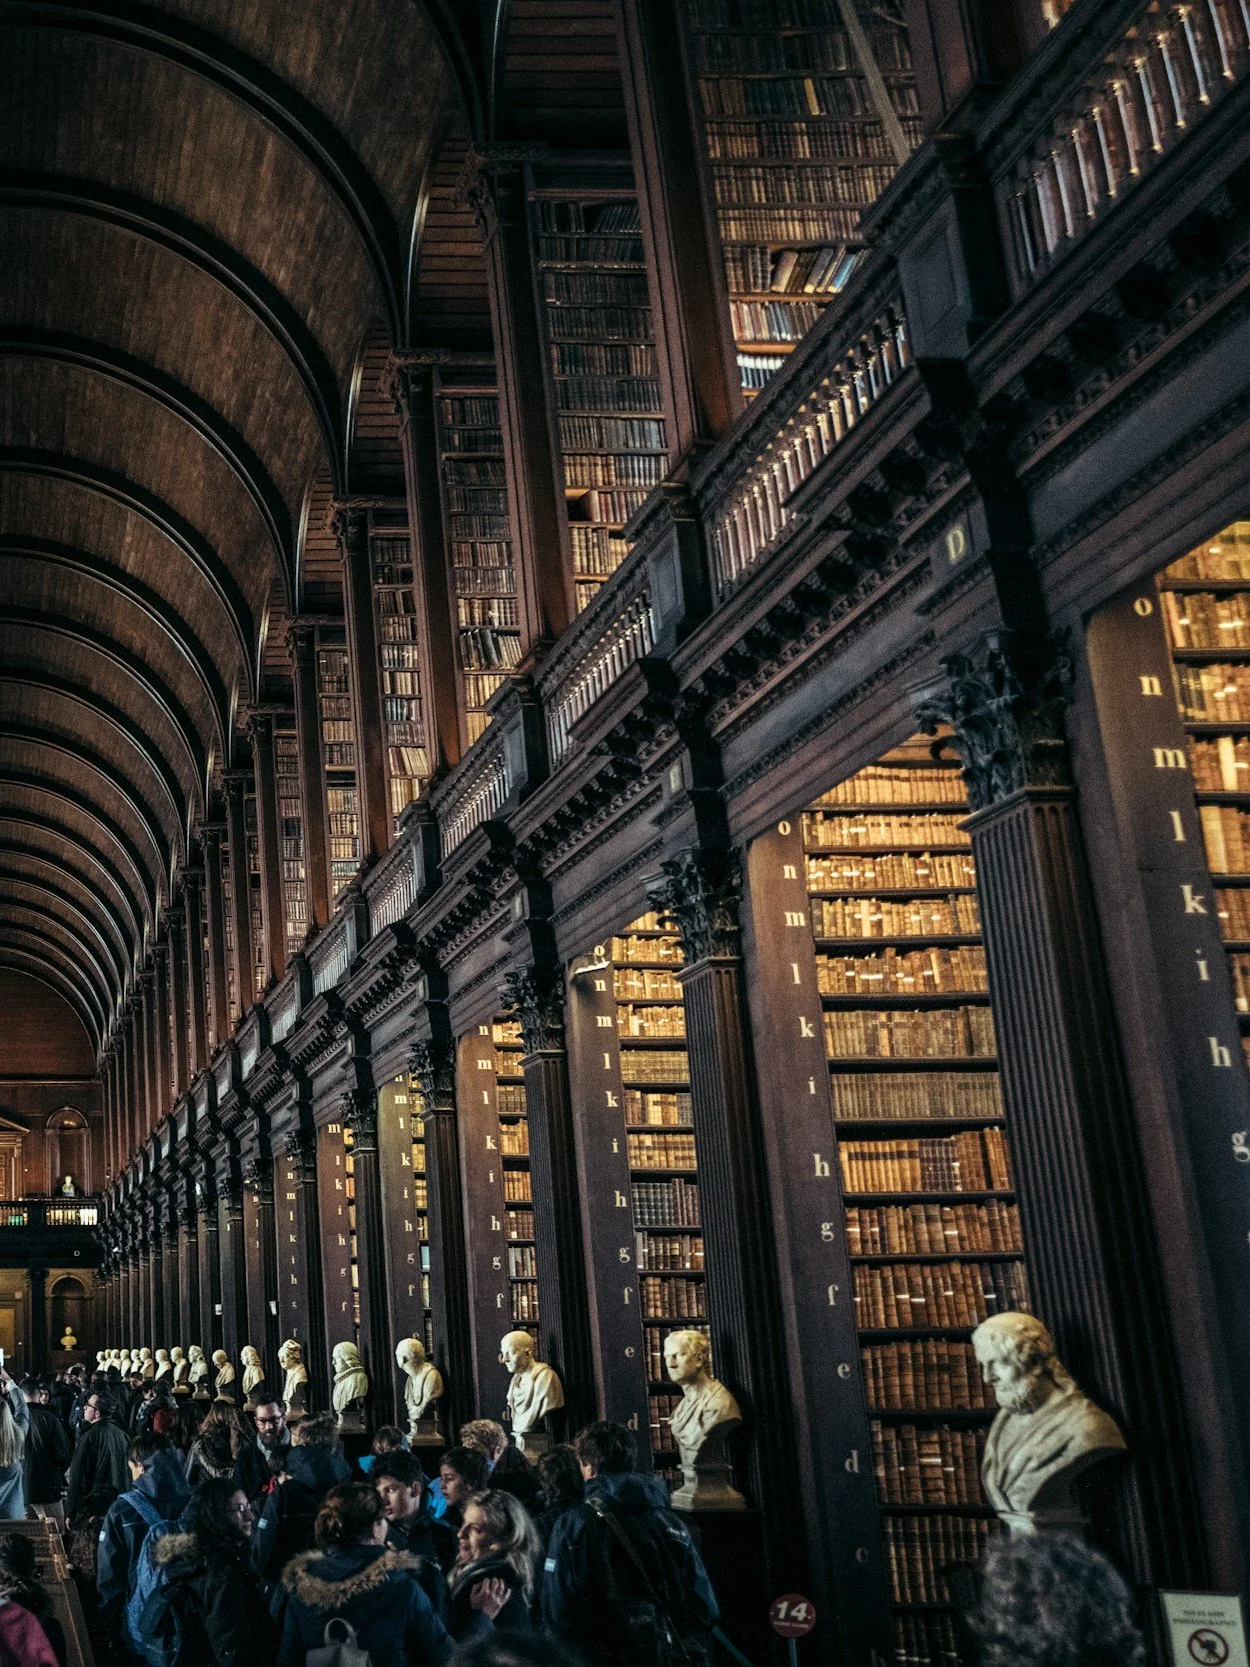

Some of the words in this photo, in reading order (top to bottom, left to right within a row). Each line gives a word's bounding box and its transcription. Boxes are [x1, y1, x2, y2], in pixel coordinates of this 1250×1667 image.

[1134, 599, 1152, 616] o
[1140, 676, 1162, 695] n
[1154, 748, 1186, 768] m
[778, 821, 791, 835] o
[1170, 811, 1185, 841] l
[784, 865, 797, 879] n
[1181, 885, 1207, 913] k
[785, 912, 805, 926] m
[594, 946, 605, 956] o
[791, 963, 800, 984] l
[1196, 950, 1209, 981] i
[595, 980, 606, 991] n
[597, 1016, 612, 1027] m
[799, 1017, 814, 1037] k
[479, 1026, 488, 1035] n
[1209, 1037, 1231, 1067] h
[477, 1060, 492, 1069] m
[395, 1095, 407, 1104] m
[606, 1091, 618, 1107] k
[328, 1124, 340, 1133] m
[486, 1136, 497, 1149] k
[1232, 1132, 1250, 1162] g
[402, 1153, 410, 1165] k
[813, 1154, 829, 1176] h
[335, 1179, 342, 1189] k
[615, 1191, 626, 1207] h
[405, 1220, 412, 1231] h
[492, 1216, 500, 1230] h
[821, 1222, 834, 1241] g
[493, 1257, 501, 1269] g
[620, 1247, 630, 1263] g
[497, 1293, 504, 1308] f
[624, 1287, 633, 1304] f
[828, 1285, 838, 1305] f
[625, 1347, 634, 1357] e
[837, 1364, 850, 1378] e
[628, 1413, 638, 1430] d
[845, 1450, 859, 1473] d
[776, 1600, 808, 1622] 14
